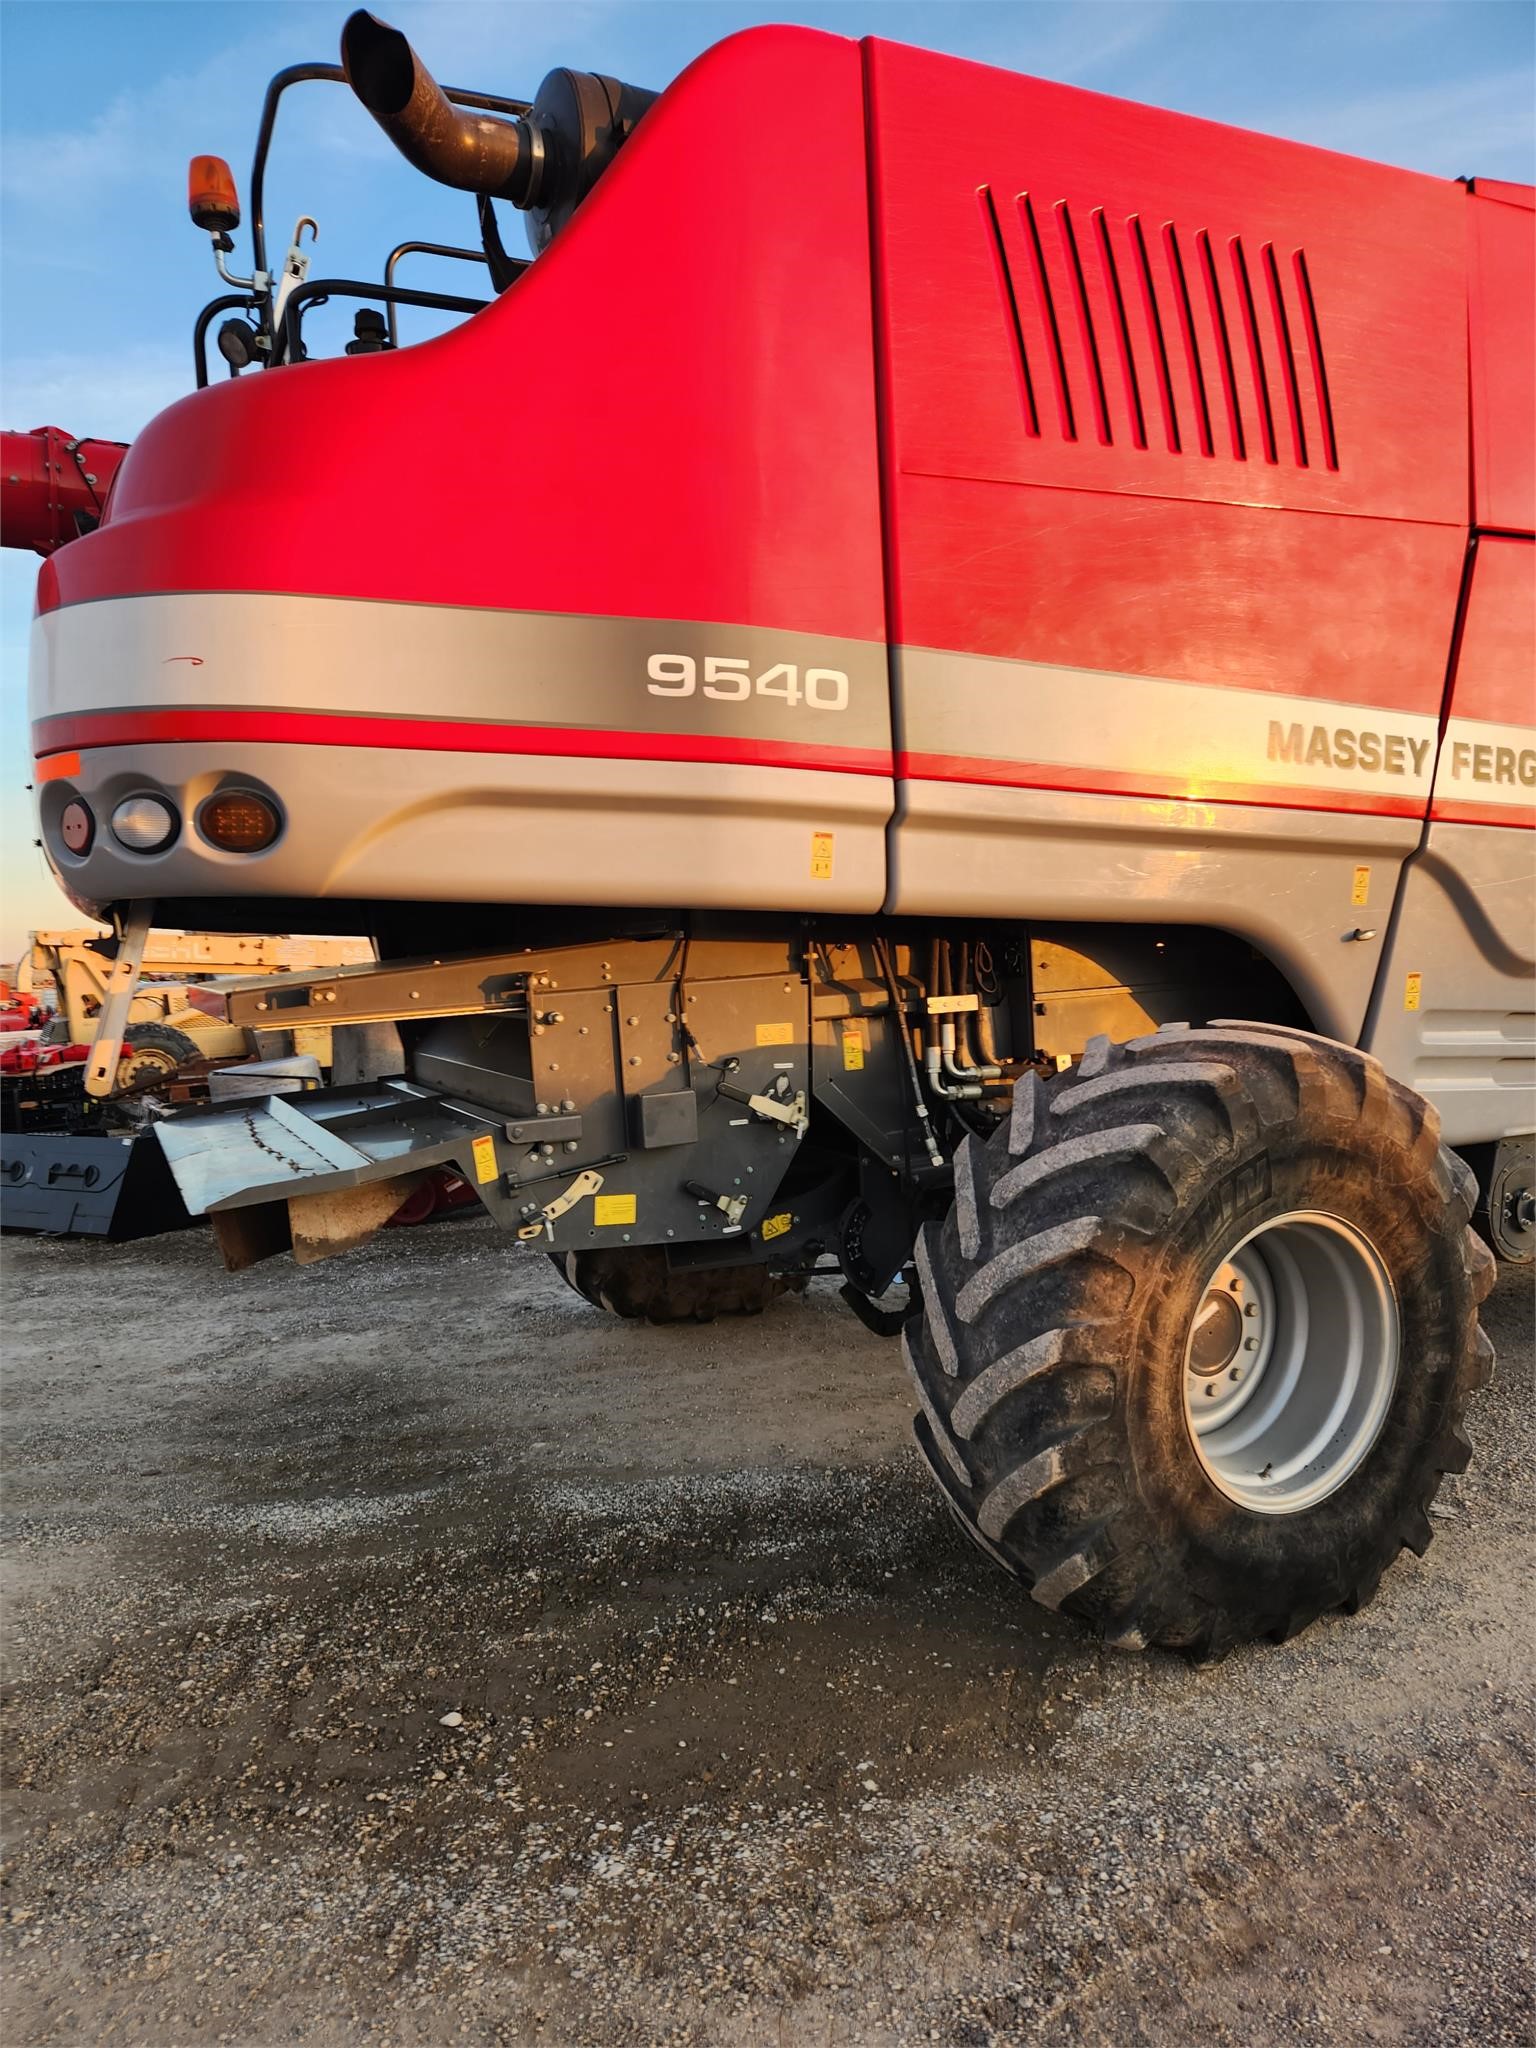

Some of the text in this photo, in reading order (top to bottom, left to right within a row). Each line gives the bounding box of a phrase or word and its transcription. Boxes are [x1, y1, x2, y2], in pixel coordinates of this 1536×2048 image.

[647, 654, 849, 710] 9540
[1266, 720, 1536, 788] MASSEY FERG
